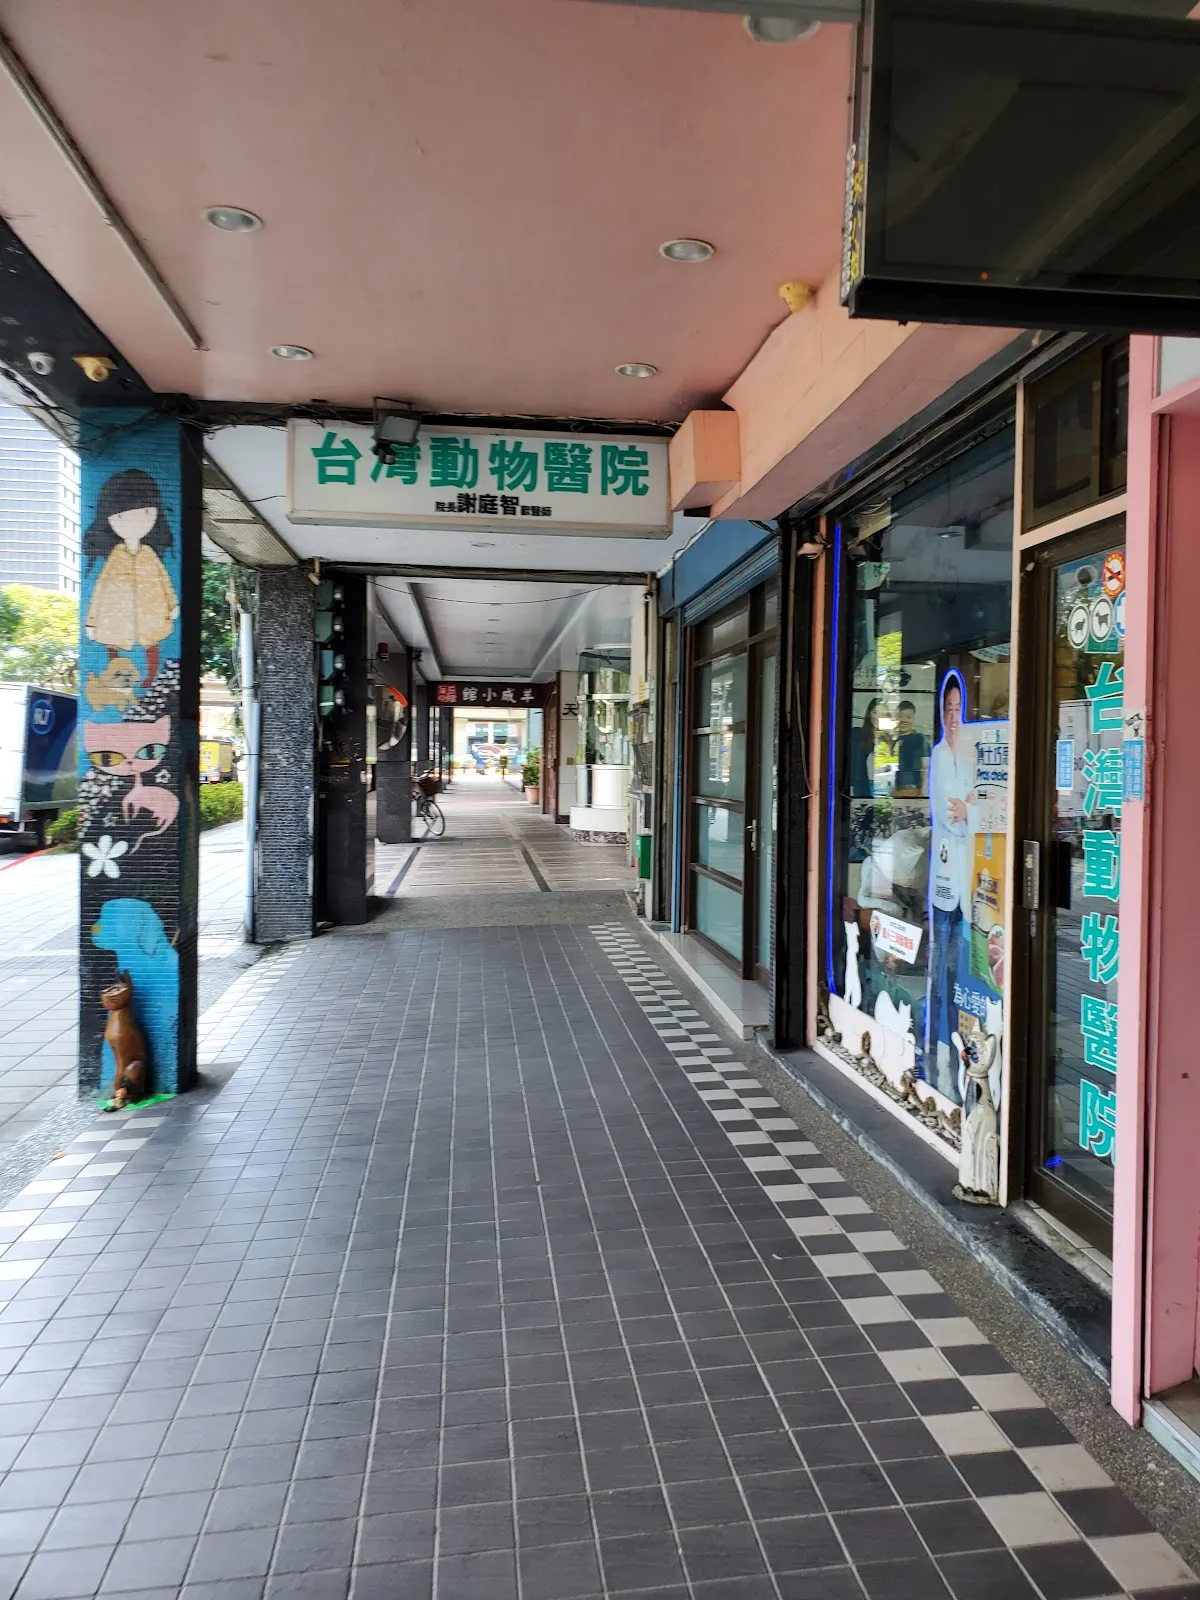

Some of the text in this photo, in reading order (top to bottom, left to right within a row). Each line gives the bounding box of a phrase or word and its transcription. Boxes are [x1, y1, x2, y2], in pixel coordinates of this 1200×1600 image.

[310, 431, 650, 496] 台灣動物醫院
[562, 703, 578, 717] 天
